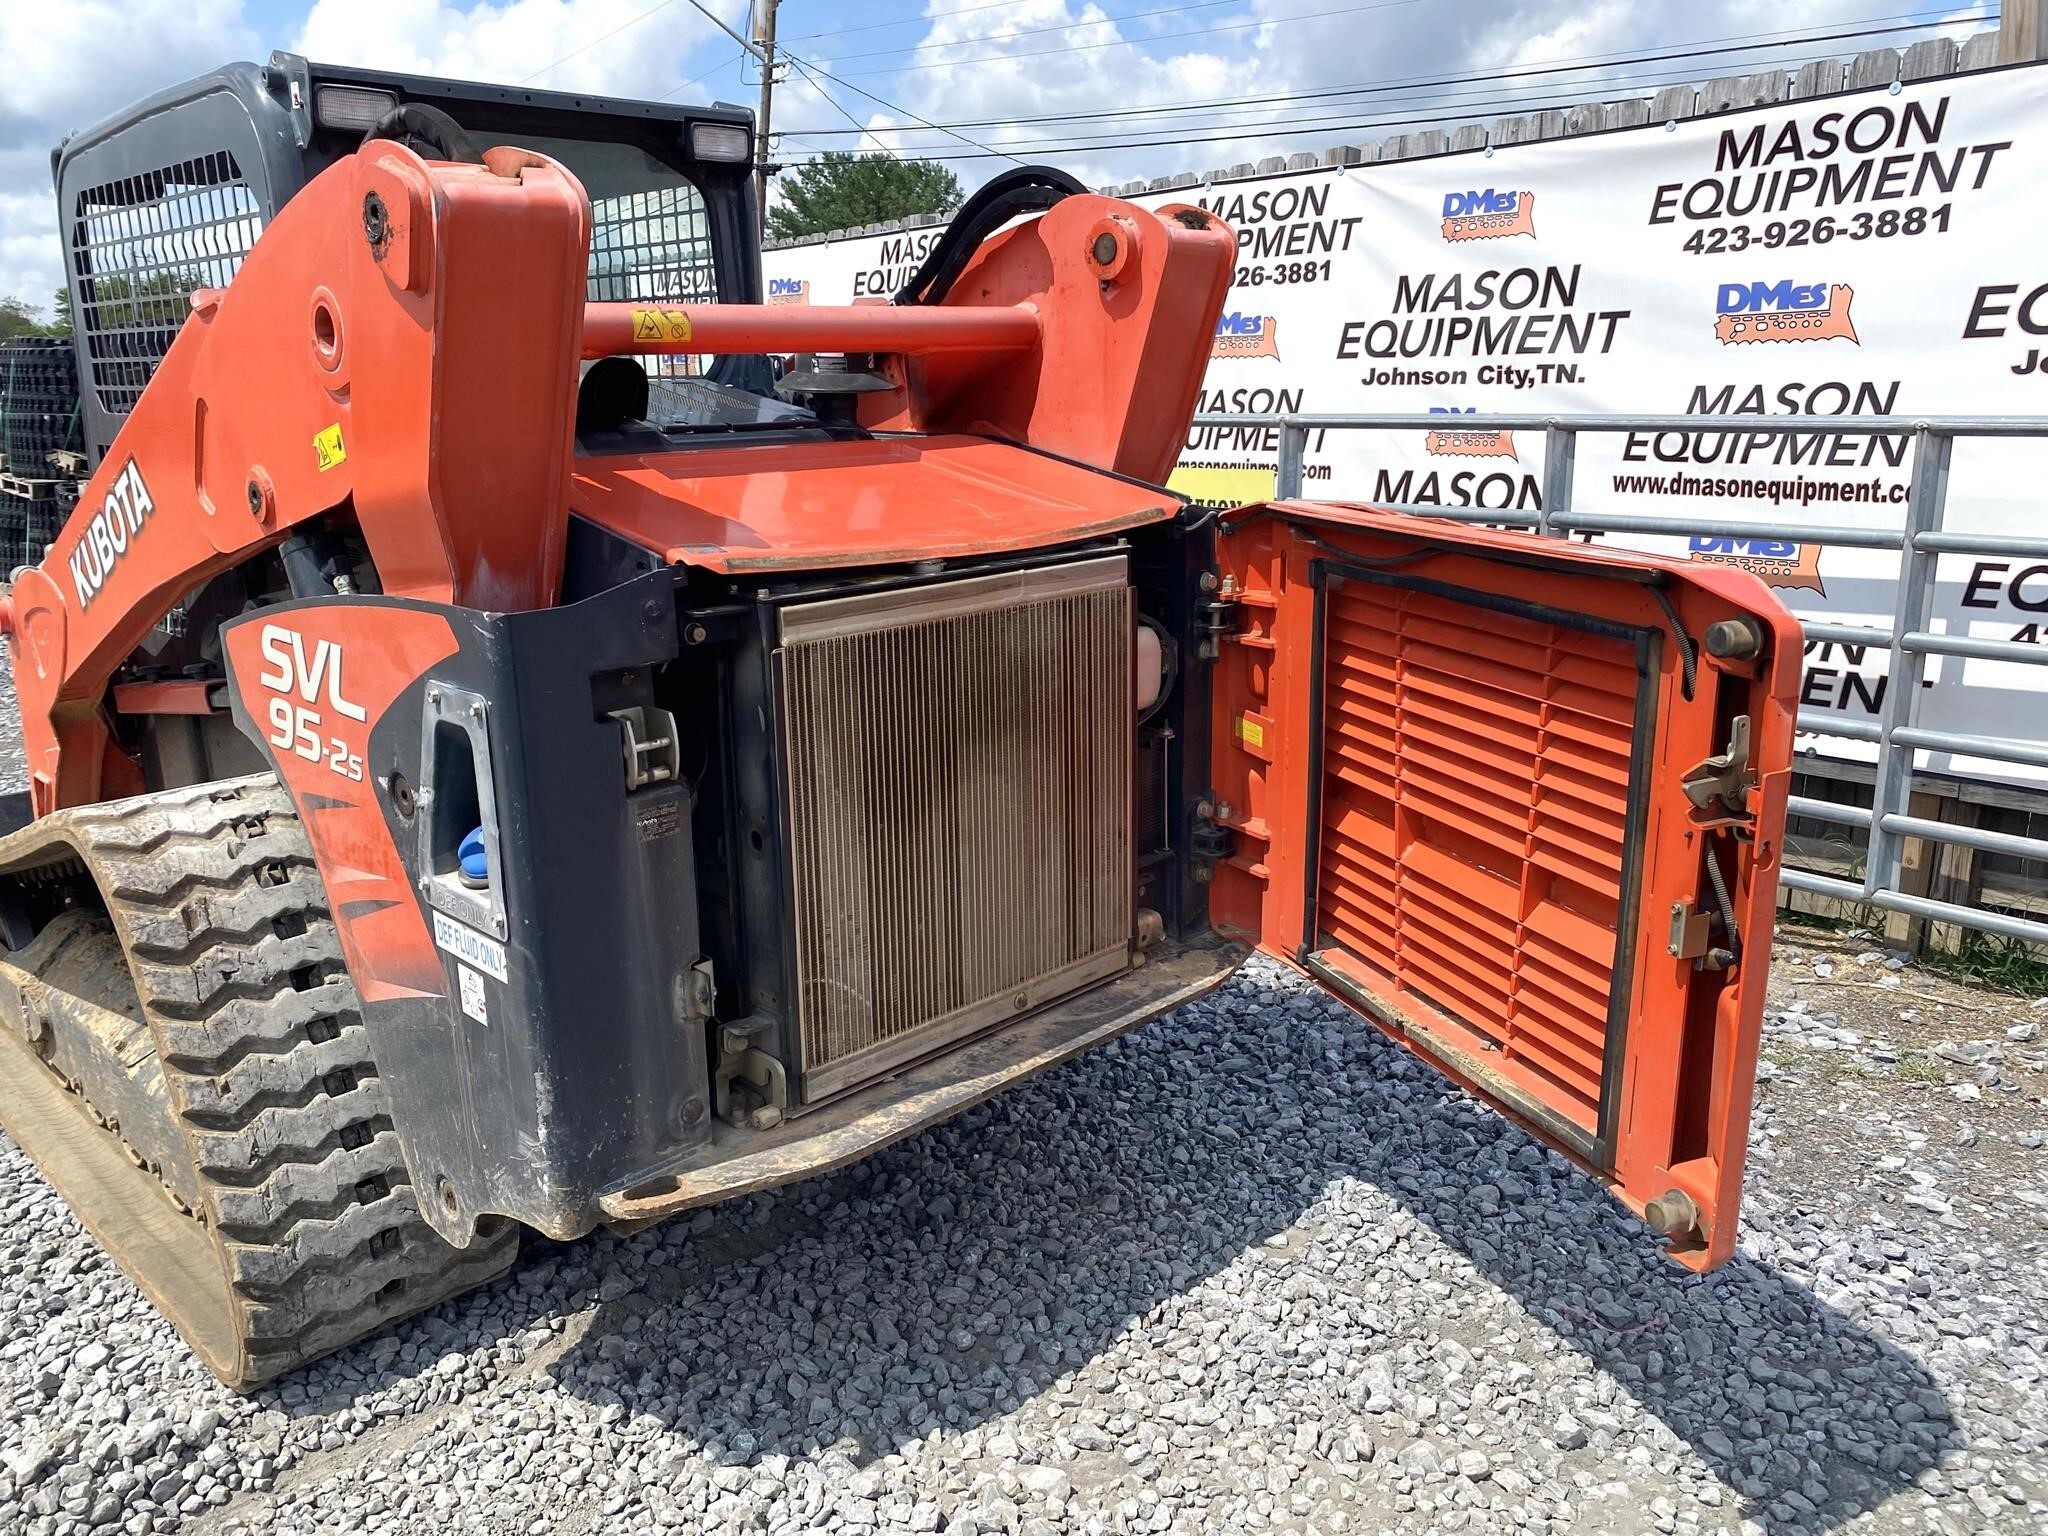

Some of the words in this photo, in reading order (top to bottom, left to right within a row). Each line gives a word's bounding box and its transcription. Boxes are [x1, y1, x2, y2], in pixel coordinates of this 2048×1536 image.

[1714, 96, 1951, 173] MASON
[1197, 183, 1330, 225] MASON
[1648, 141, 2013, 225] EQUIPMENT
[1682, 203, 1953, 255] 423-926-3881
[1391, 264, 1582, 314] MASON
[1336, 310, 1631, 359] EQUIPMENT
[1361, 367, 1468, 386] Johnson
[1477, 363, 1586, 390] City,TN.
[1685, 380, 1902, 416] MASON
[68, 458, 154, 611] KUBOTA
[260, 624, 367, 723] SVL
[437, 918, 452, 945] DEF
[454, 928, 479, 961] FLUID
[480, 942, 504, 974] ONLY
